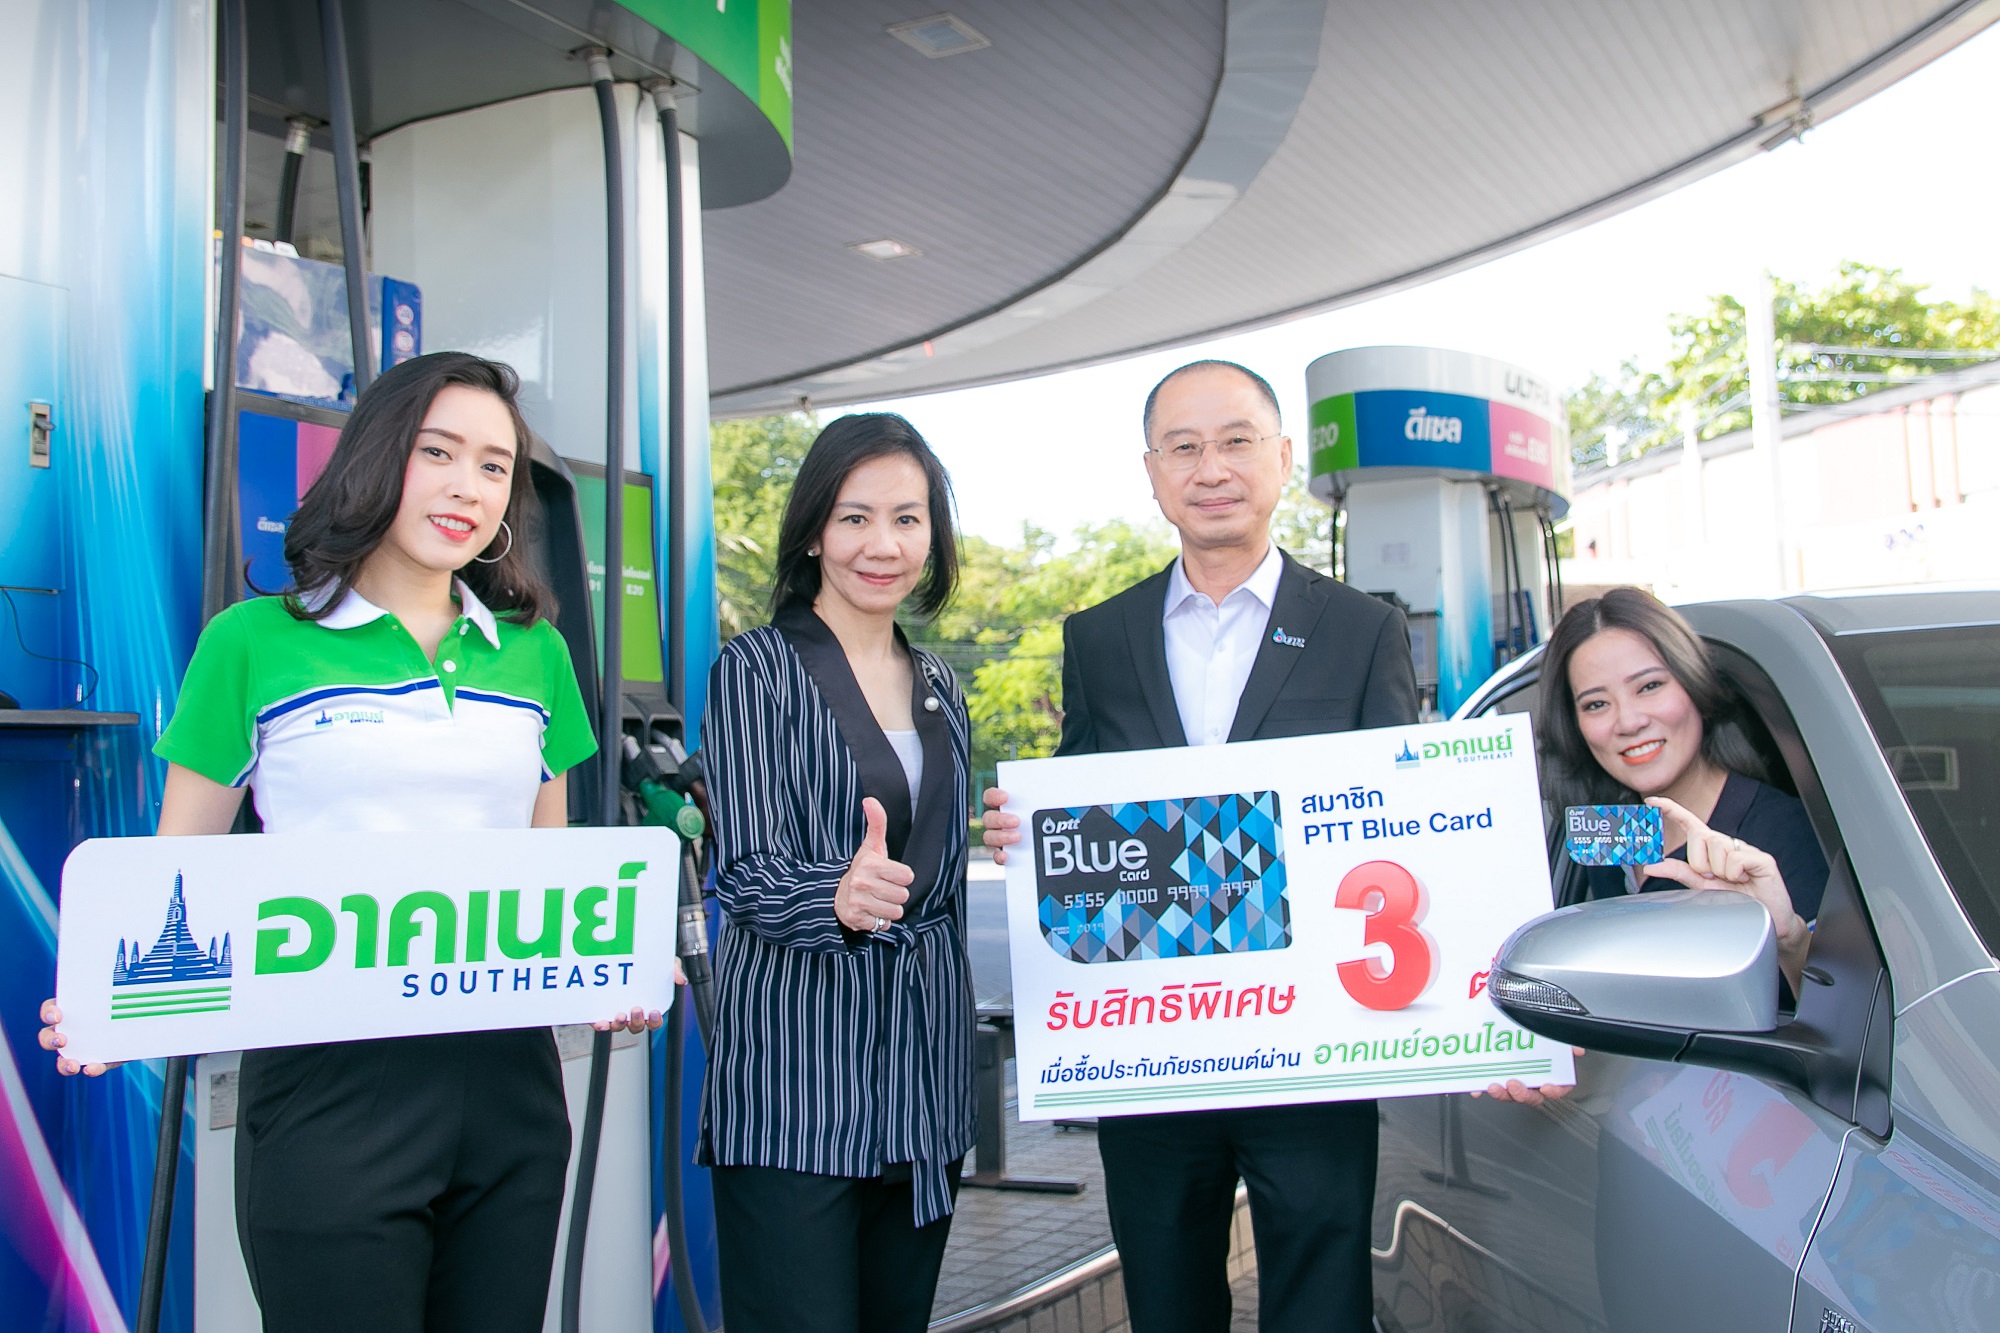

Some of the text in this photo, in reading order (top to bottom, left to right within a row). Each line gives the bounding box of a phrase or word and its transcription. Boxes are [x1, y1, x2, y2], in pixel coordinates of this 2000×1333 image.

[1405, 406, 1463, 444] ดีเซล
[1422, 727, 1513, 759] อาคเนย์
[1457, 751, 1514, 764] SOUTHEAST
[1301, 786, 1384, 814] สมาชิก
[1055, 817, 1081, 834] ptt
[1304, 807, 1493, 845] PTT Blue Card
[1569, 816, 1611, 832] Blue
[1042, 834, 1148, 877] Blue
[1119, 868, 1150, 882] Card
[1064, 879, 1262, 910] 5555 0000 9999 9999
[254, 860, 648, 976] อาคเนย์
[1334, 859, 1434, 1011] 3
[402, 962, 634, 998] SOUTHEAST
[1046, 981, 1296, 1031] รับสิทธิพิเศษ
[1040, 1021, 1536, 1084] เมื่อซื้อประกันภัยรถยนต์ผ่าน อาคเนย์ออนไลน
